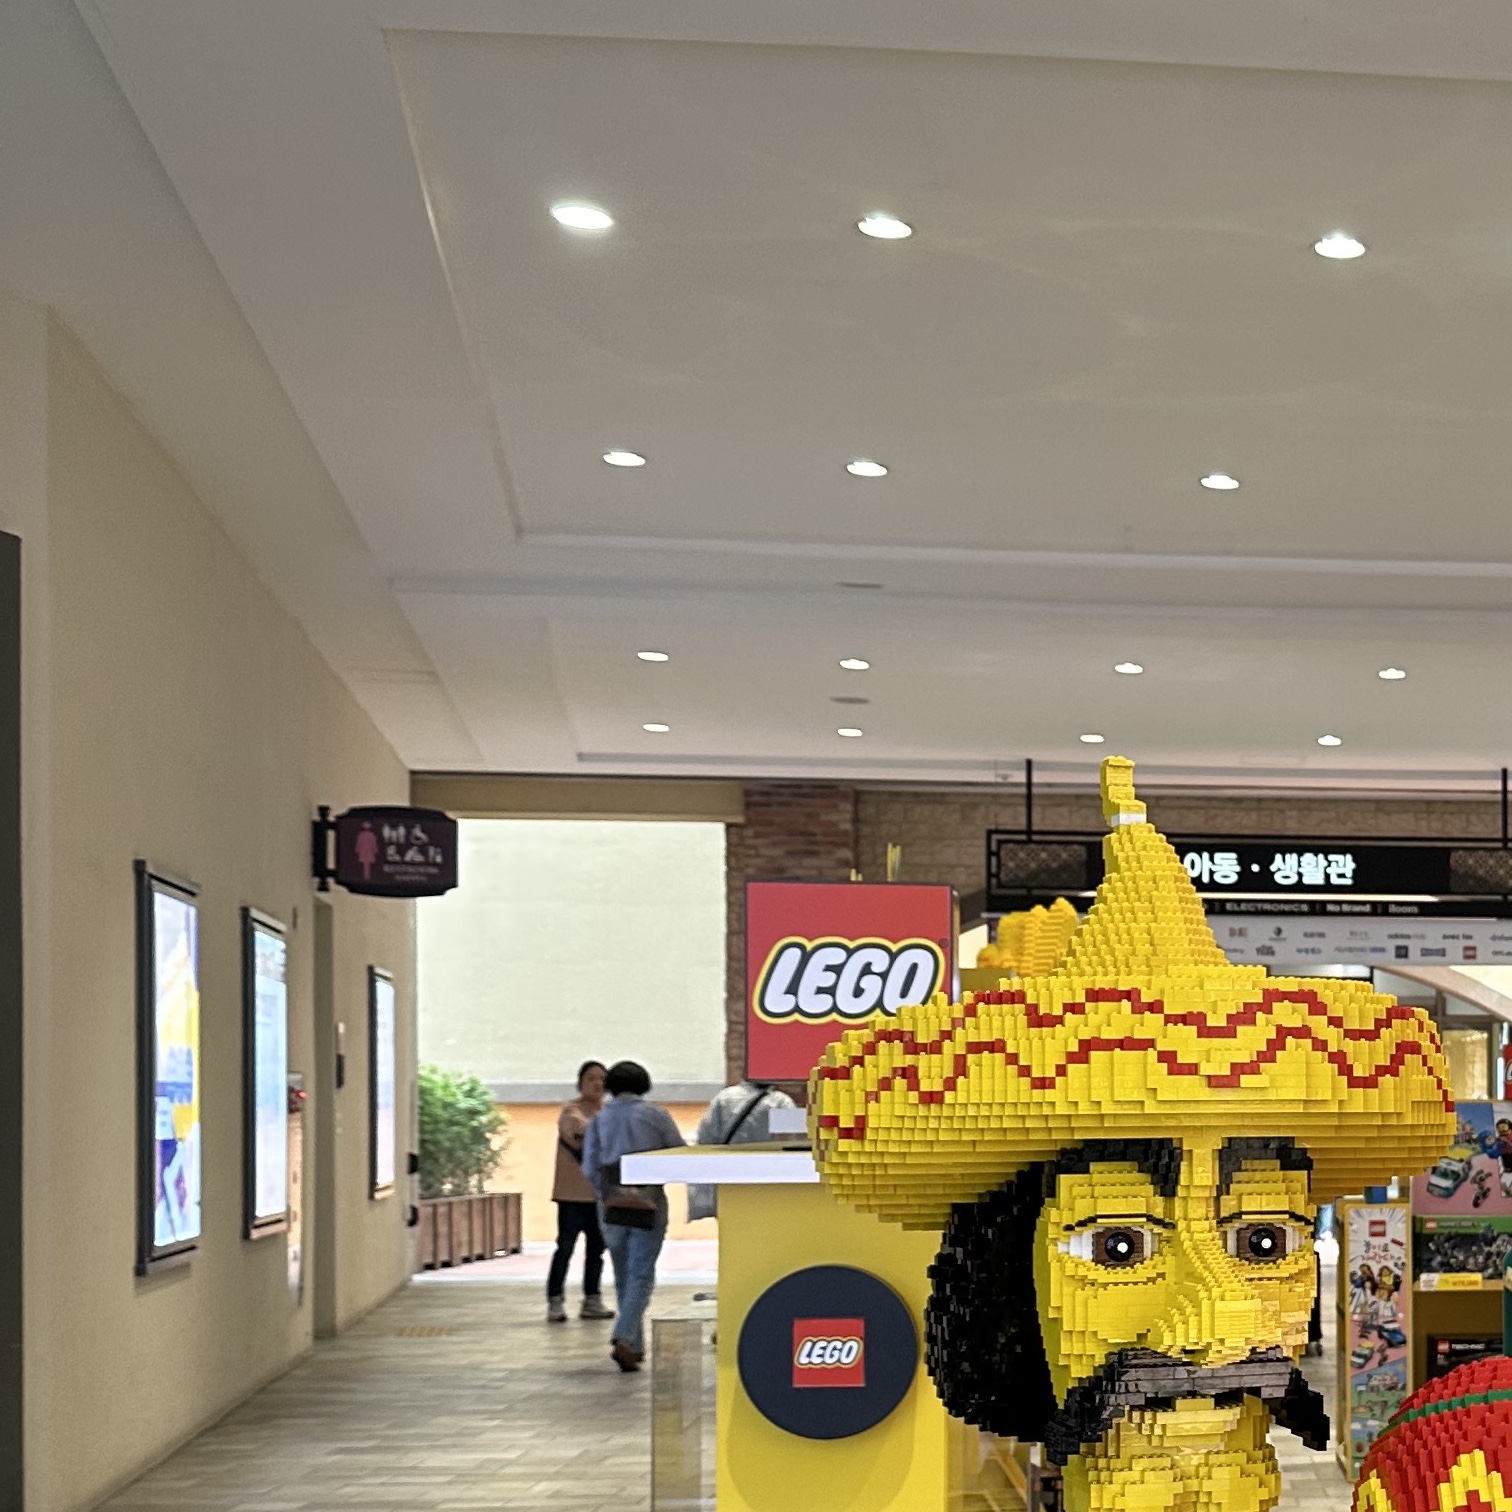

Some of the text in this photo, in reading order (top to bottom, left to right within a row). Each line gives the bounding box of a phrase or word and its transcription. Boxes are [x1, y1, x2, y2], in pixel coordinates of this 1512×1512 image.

[1269, 852, 1357, 885] 생활관
[759, 942, 941, 1019] LEGO
[797, 1338, 861, 1367] LEGO
